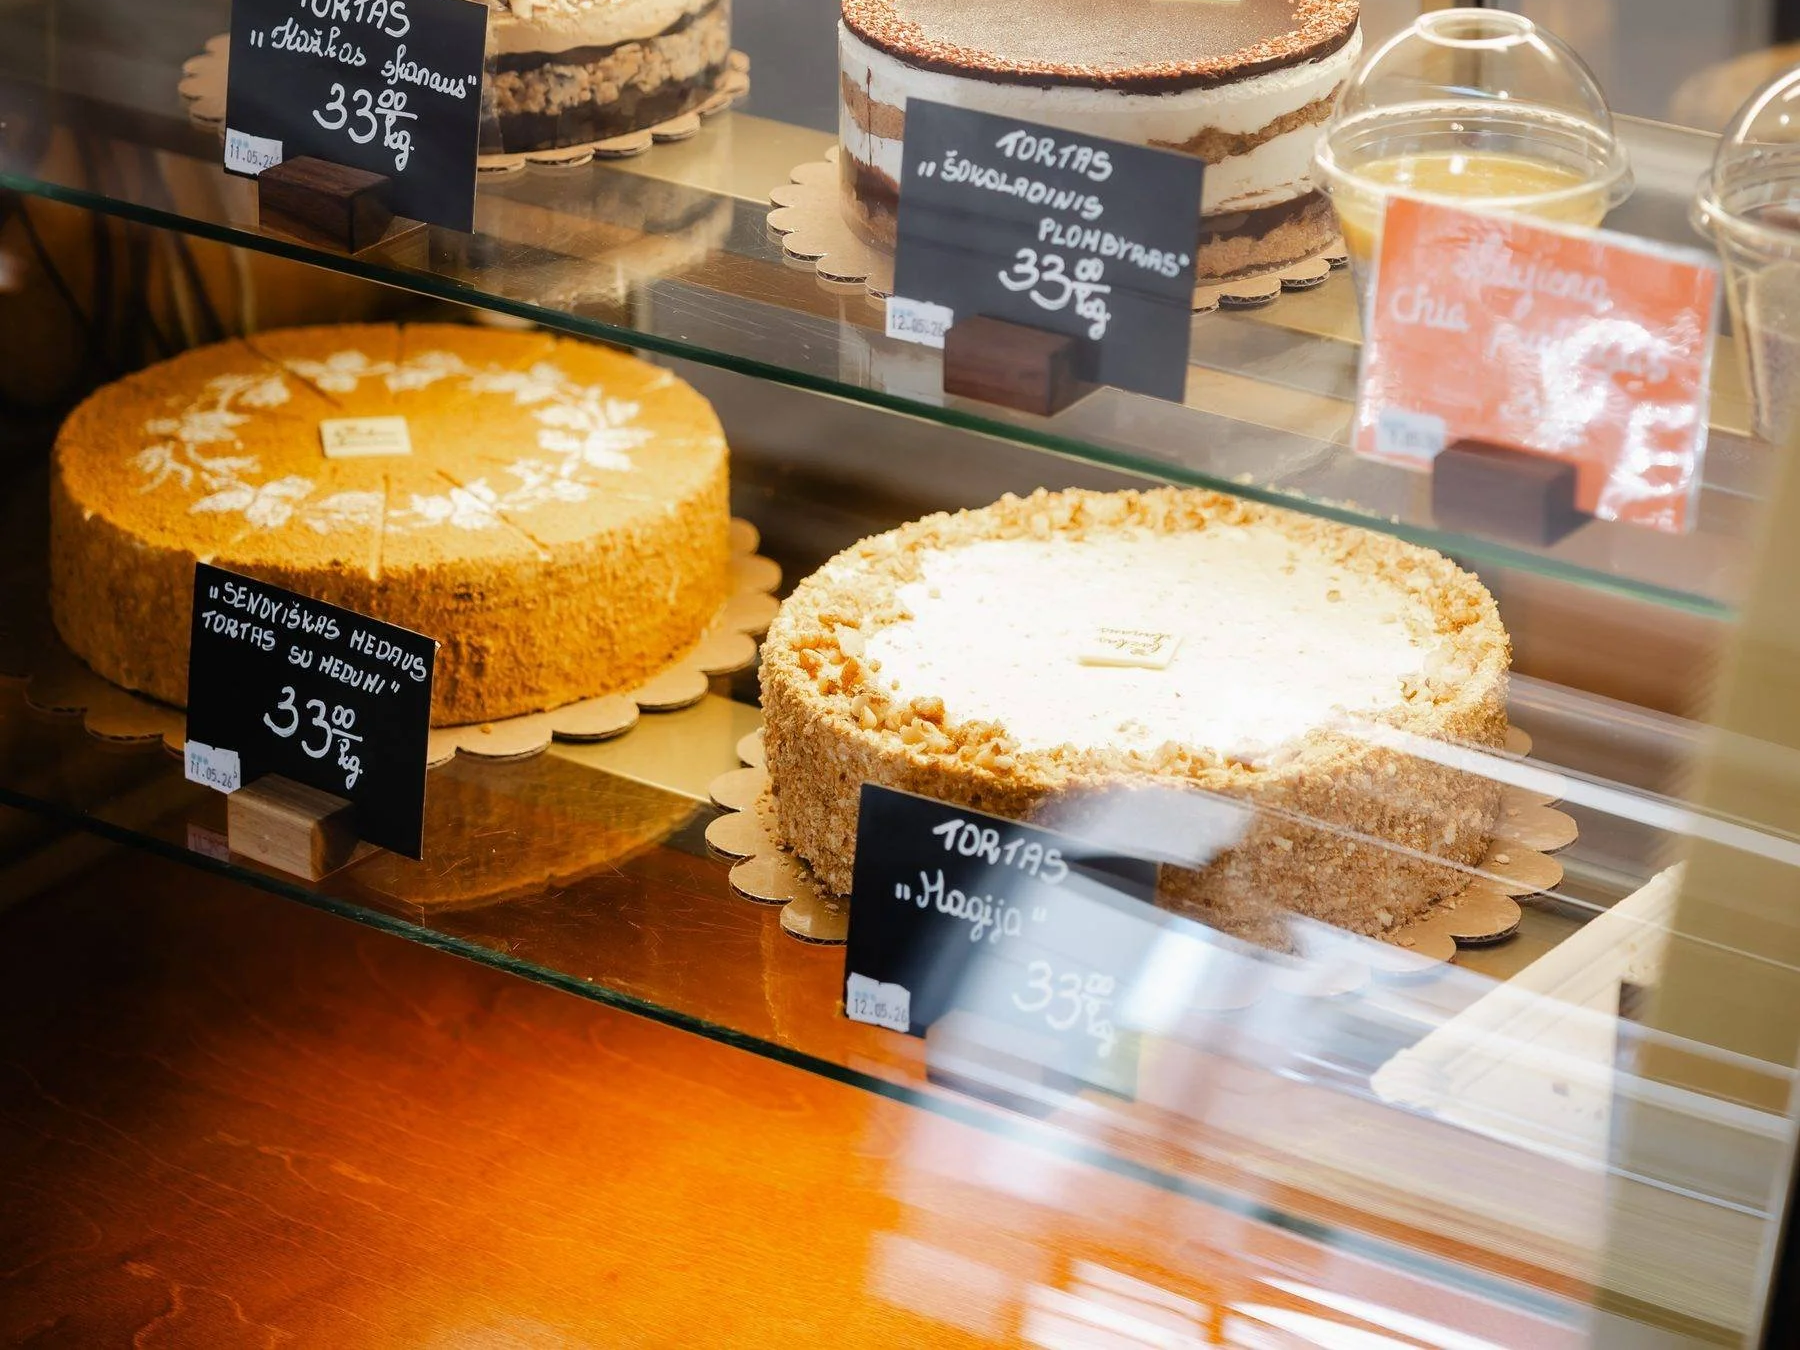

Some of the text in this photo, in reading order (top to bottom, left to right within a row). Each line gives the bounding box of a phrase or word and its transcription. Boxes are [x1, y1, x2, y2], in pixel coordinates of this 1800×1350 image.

[312, 82, 378, 144] 33
[995, 129, 1113, 182] TORTAS
[998, 247, 1073, 311] 33
[201, 610, 276, 651] TORTAS
[287, 645, 314, 669] SU
[349, 629, 427, 682] MEDAUS
[263, 685, 333, 759] 33
[190, 760, 233, 789] 11.05.26
[932, 818, 1070, 885] TORTAS
